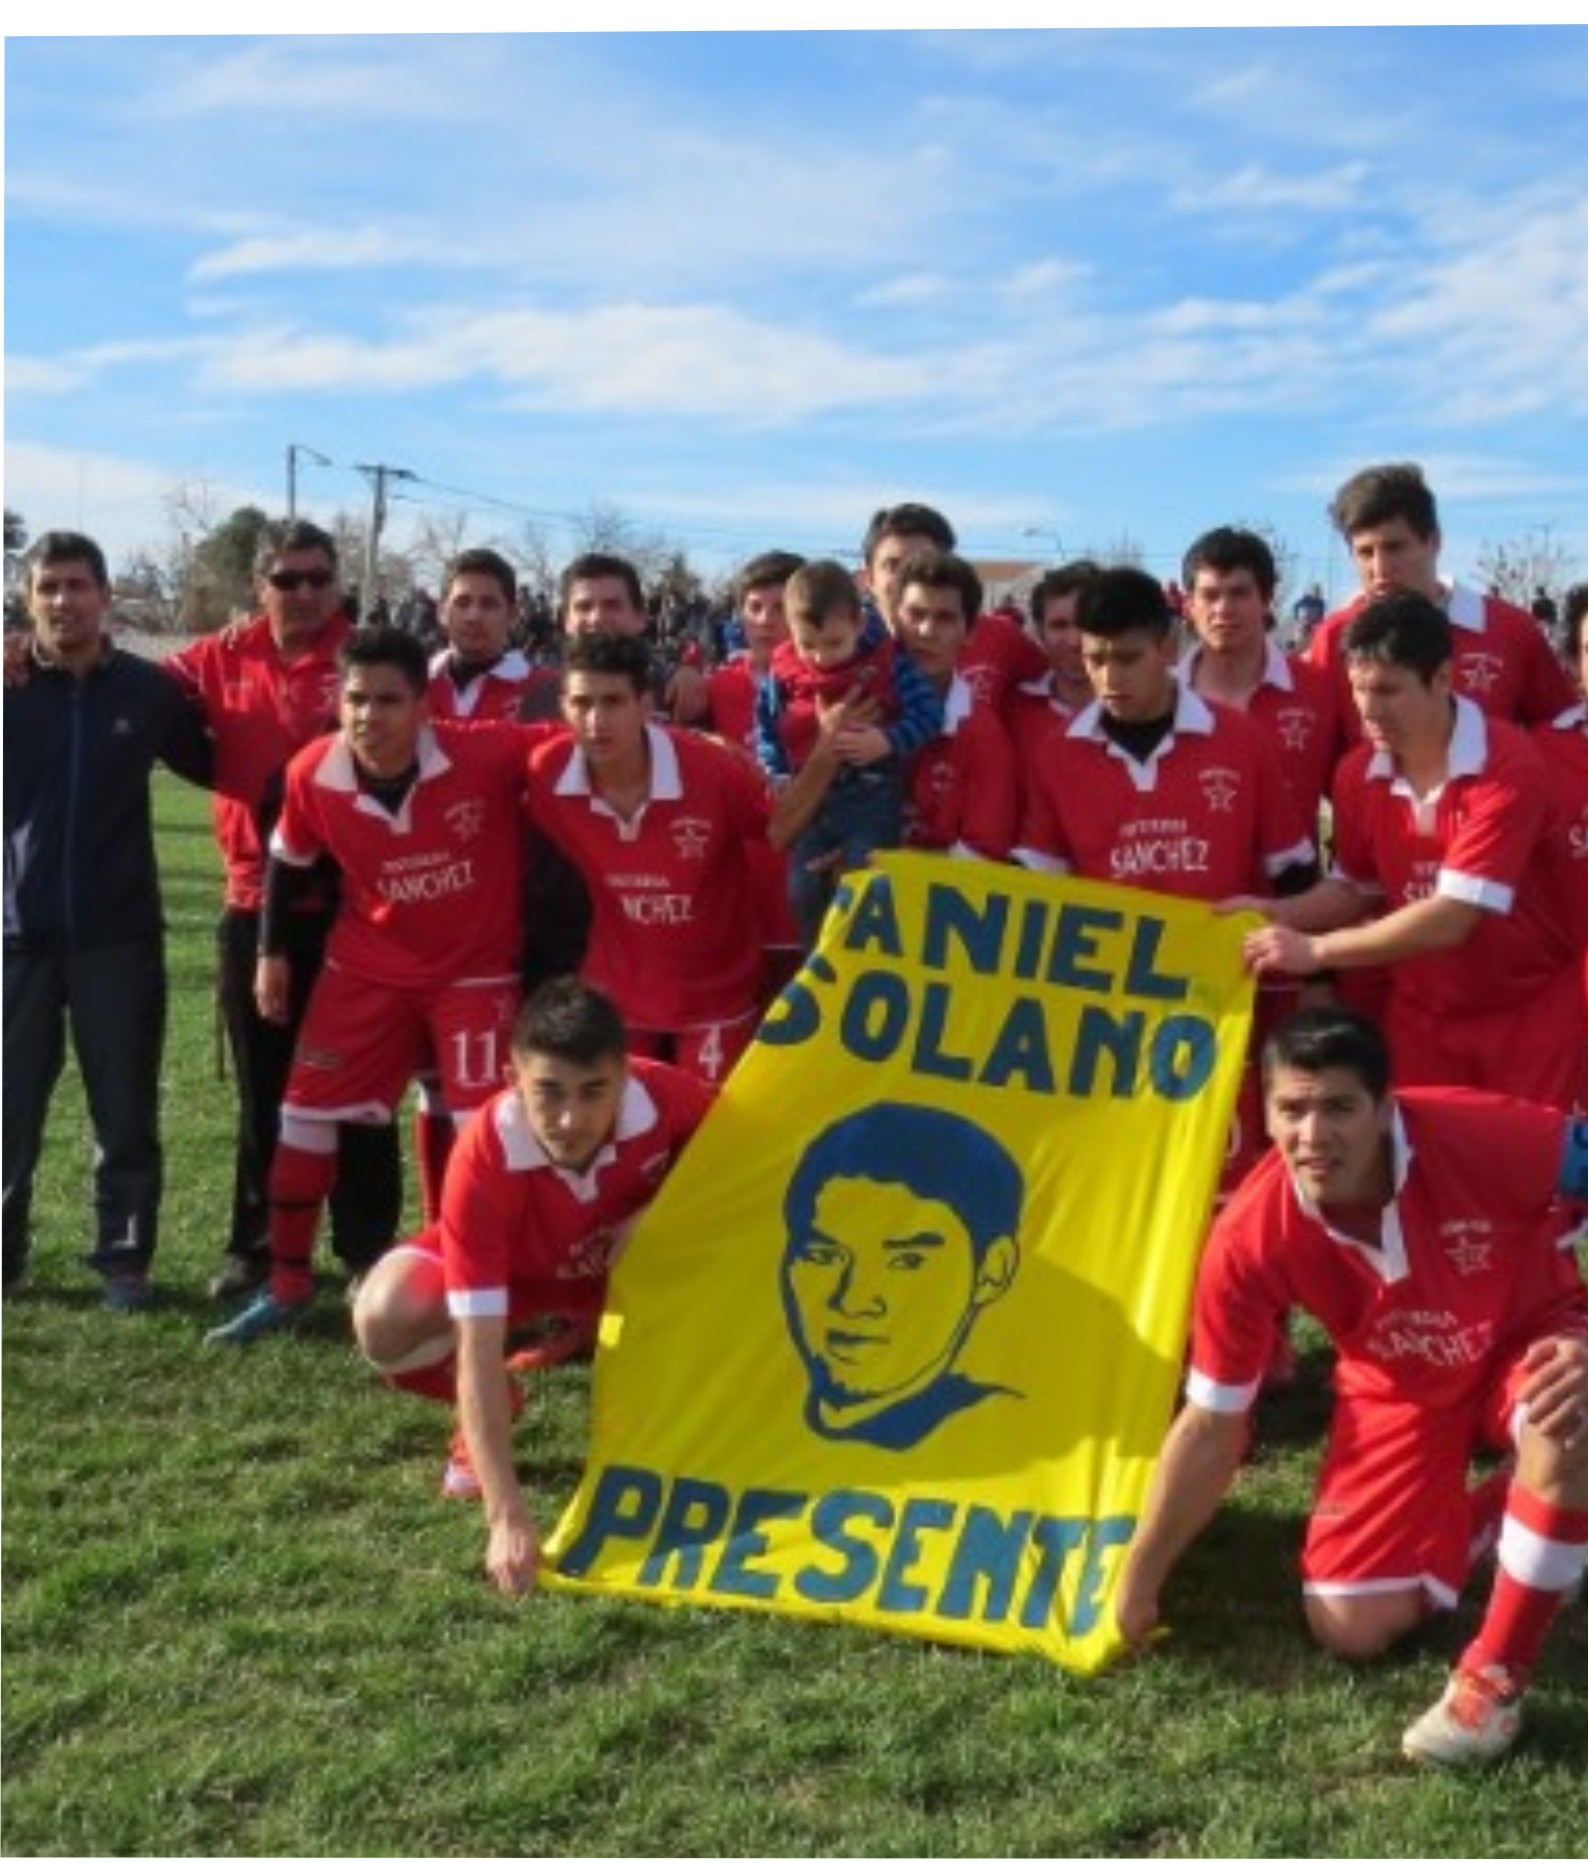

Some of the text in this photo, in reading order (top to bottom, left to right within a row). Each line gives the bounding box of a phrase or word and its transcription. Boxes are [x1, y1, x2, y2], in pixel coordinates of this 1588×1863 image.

[1109, 836, 1210, 882] SANCHEZ
[619, 892, 697, 926] NCHEZ
[839, 873, 1190, 1001] ANIEL
[697, 1024, 724, 1081] 4
[756, 953, 1217, 1103] SOLANO
[452, 1029, 498, 1088] 11
[556, 1464, 1137, 1638] PRESENTE
